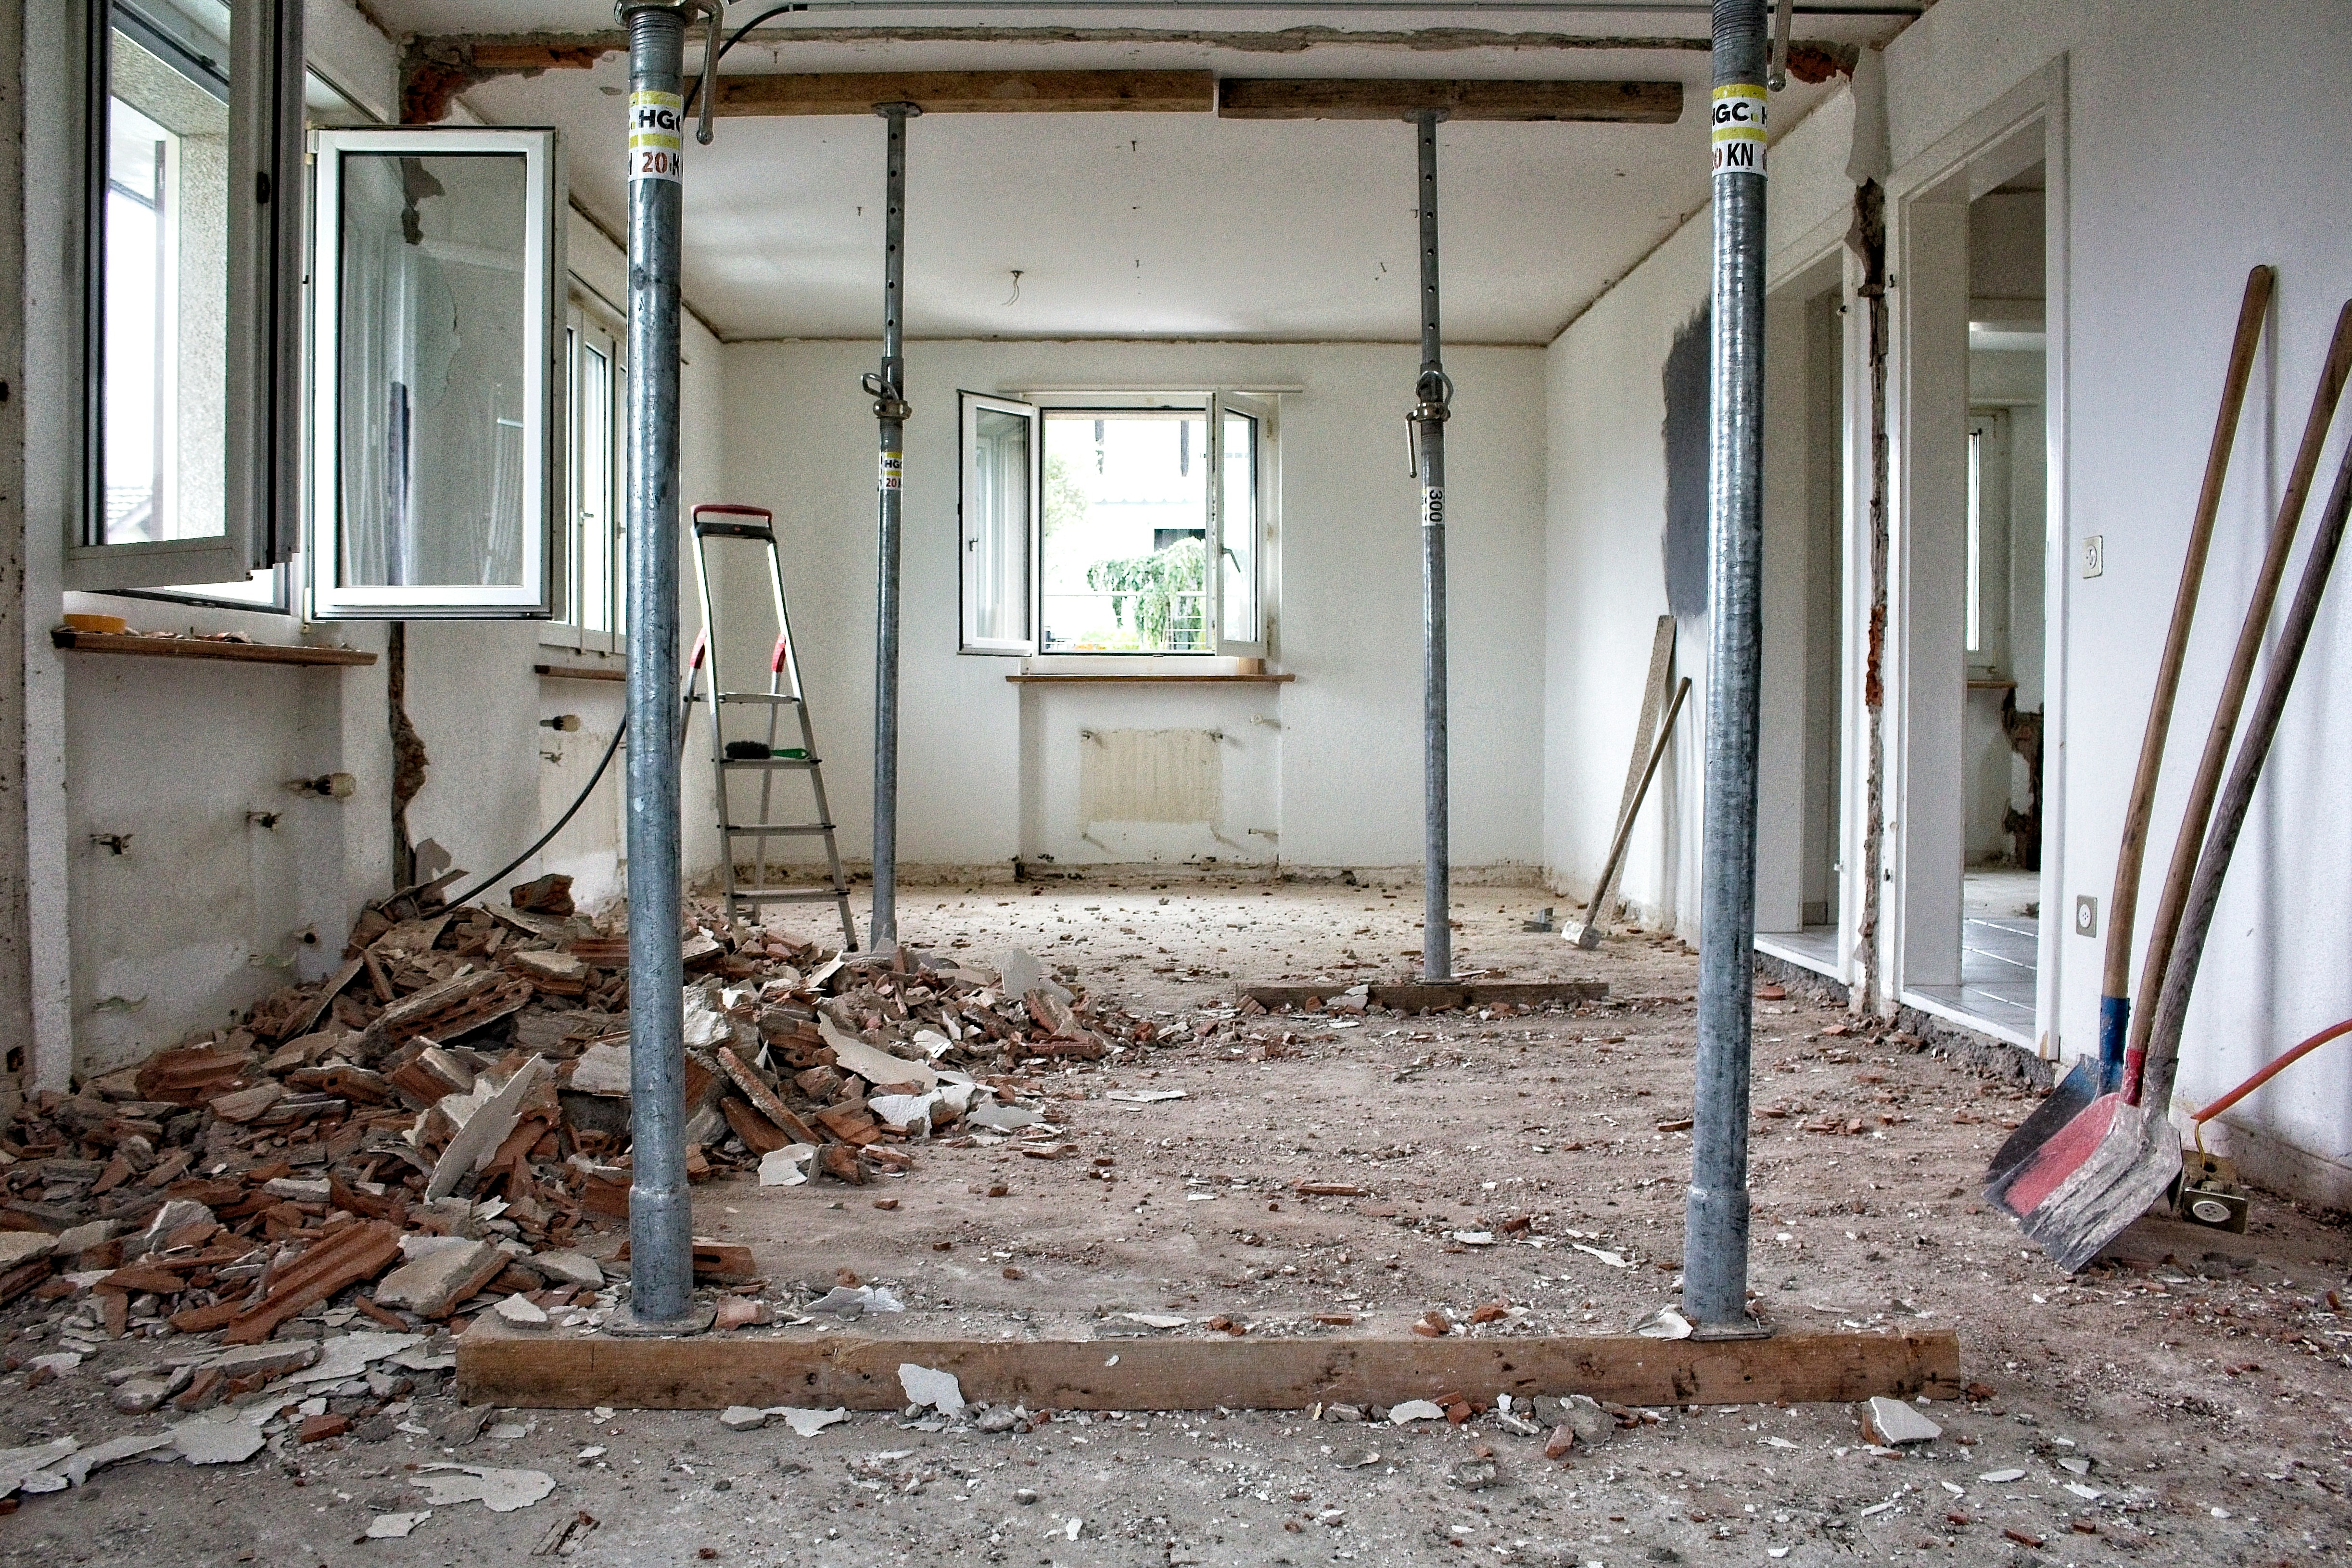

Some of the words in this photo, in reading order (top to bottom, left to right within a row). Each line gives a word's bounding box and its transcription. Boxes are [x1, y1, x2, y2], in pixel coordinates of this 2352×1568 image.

[642, 152, 668, 173] 20
[1728, 143, 1754, 167] KN
[884, 459, 902, 469] HG
[886, 478, 897, 487] 20
[1429, 489, 1443, 522] 300
